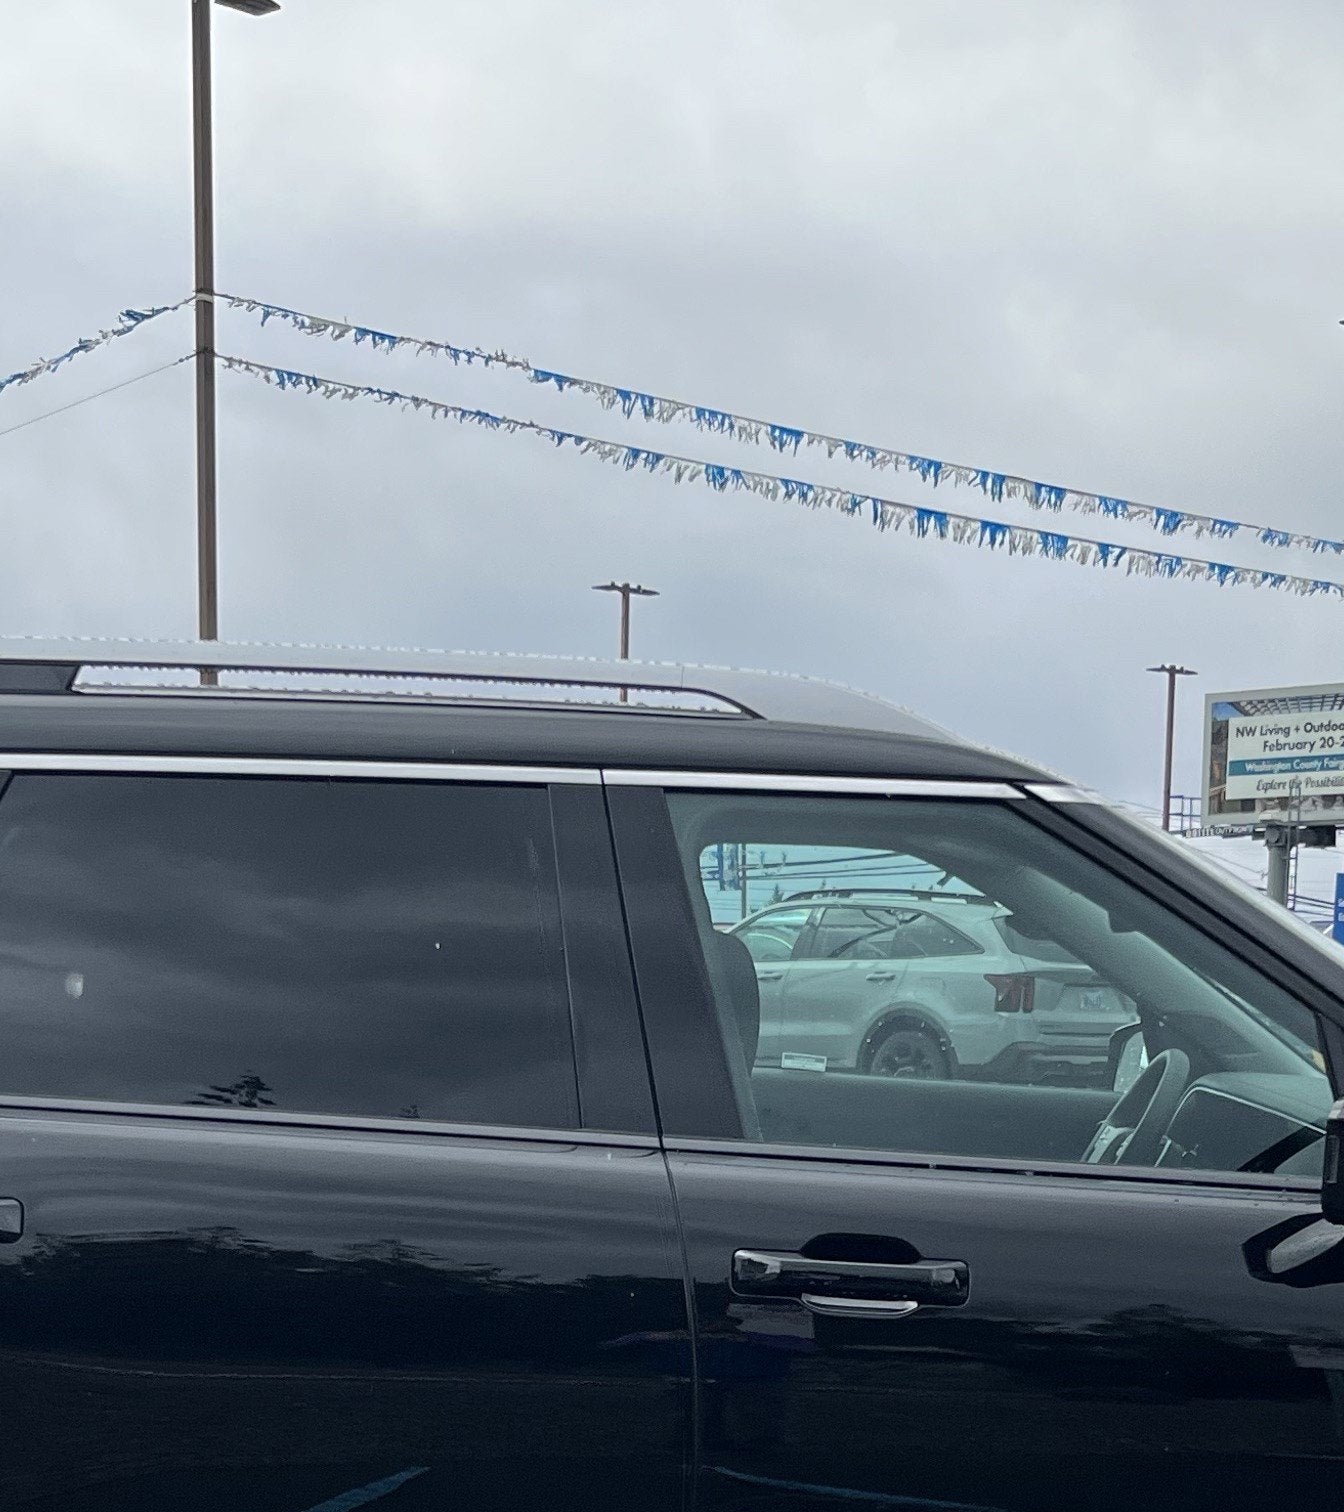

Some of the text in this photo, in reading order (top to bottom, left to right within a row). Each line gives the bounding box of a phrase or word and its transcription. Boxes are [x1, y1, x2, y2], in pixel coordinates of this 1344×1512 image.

[1235, 725, 1256, 738] NW
[1260, 722, 1291, 736] Living
[1263, 738, 1316, 753] February
[1293, 759, 1322, 772] County
